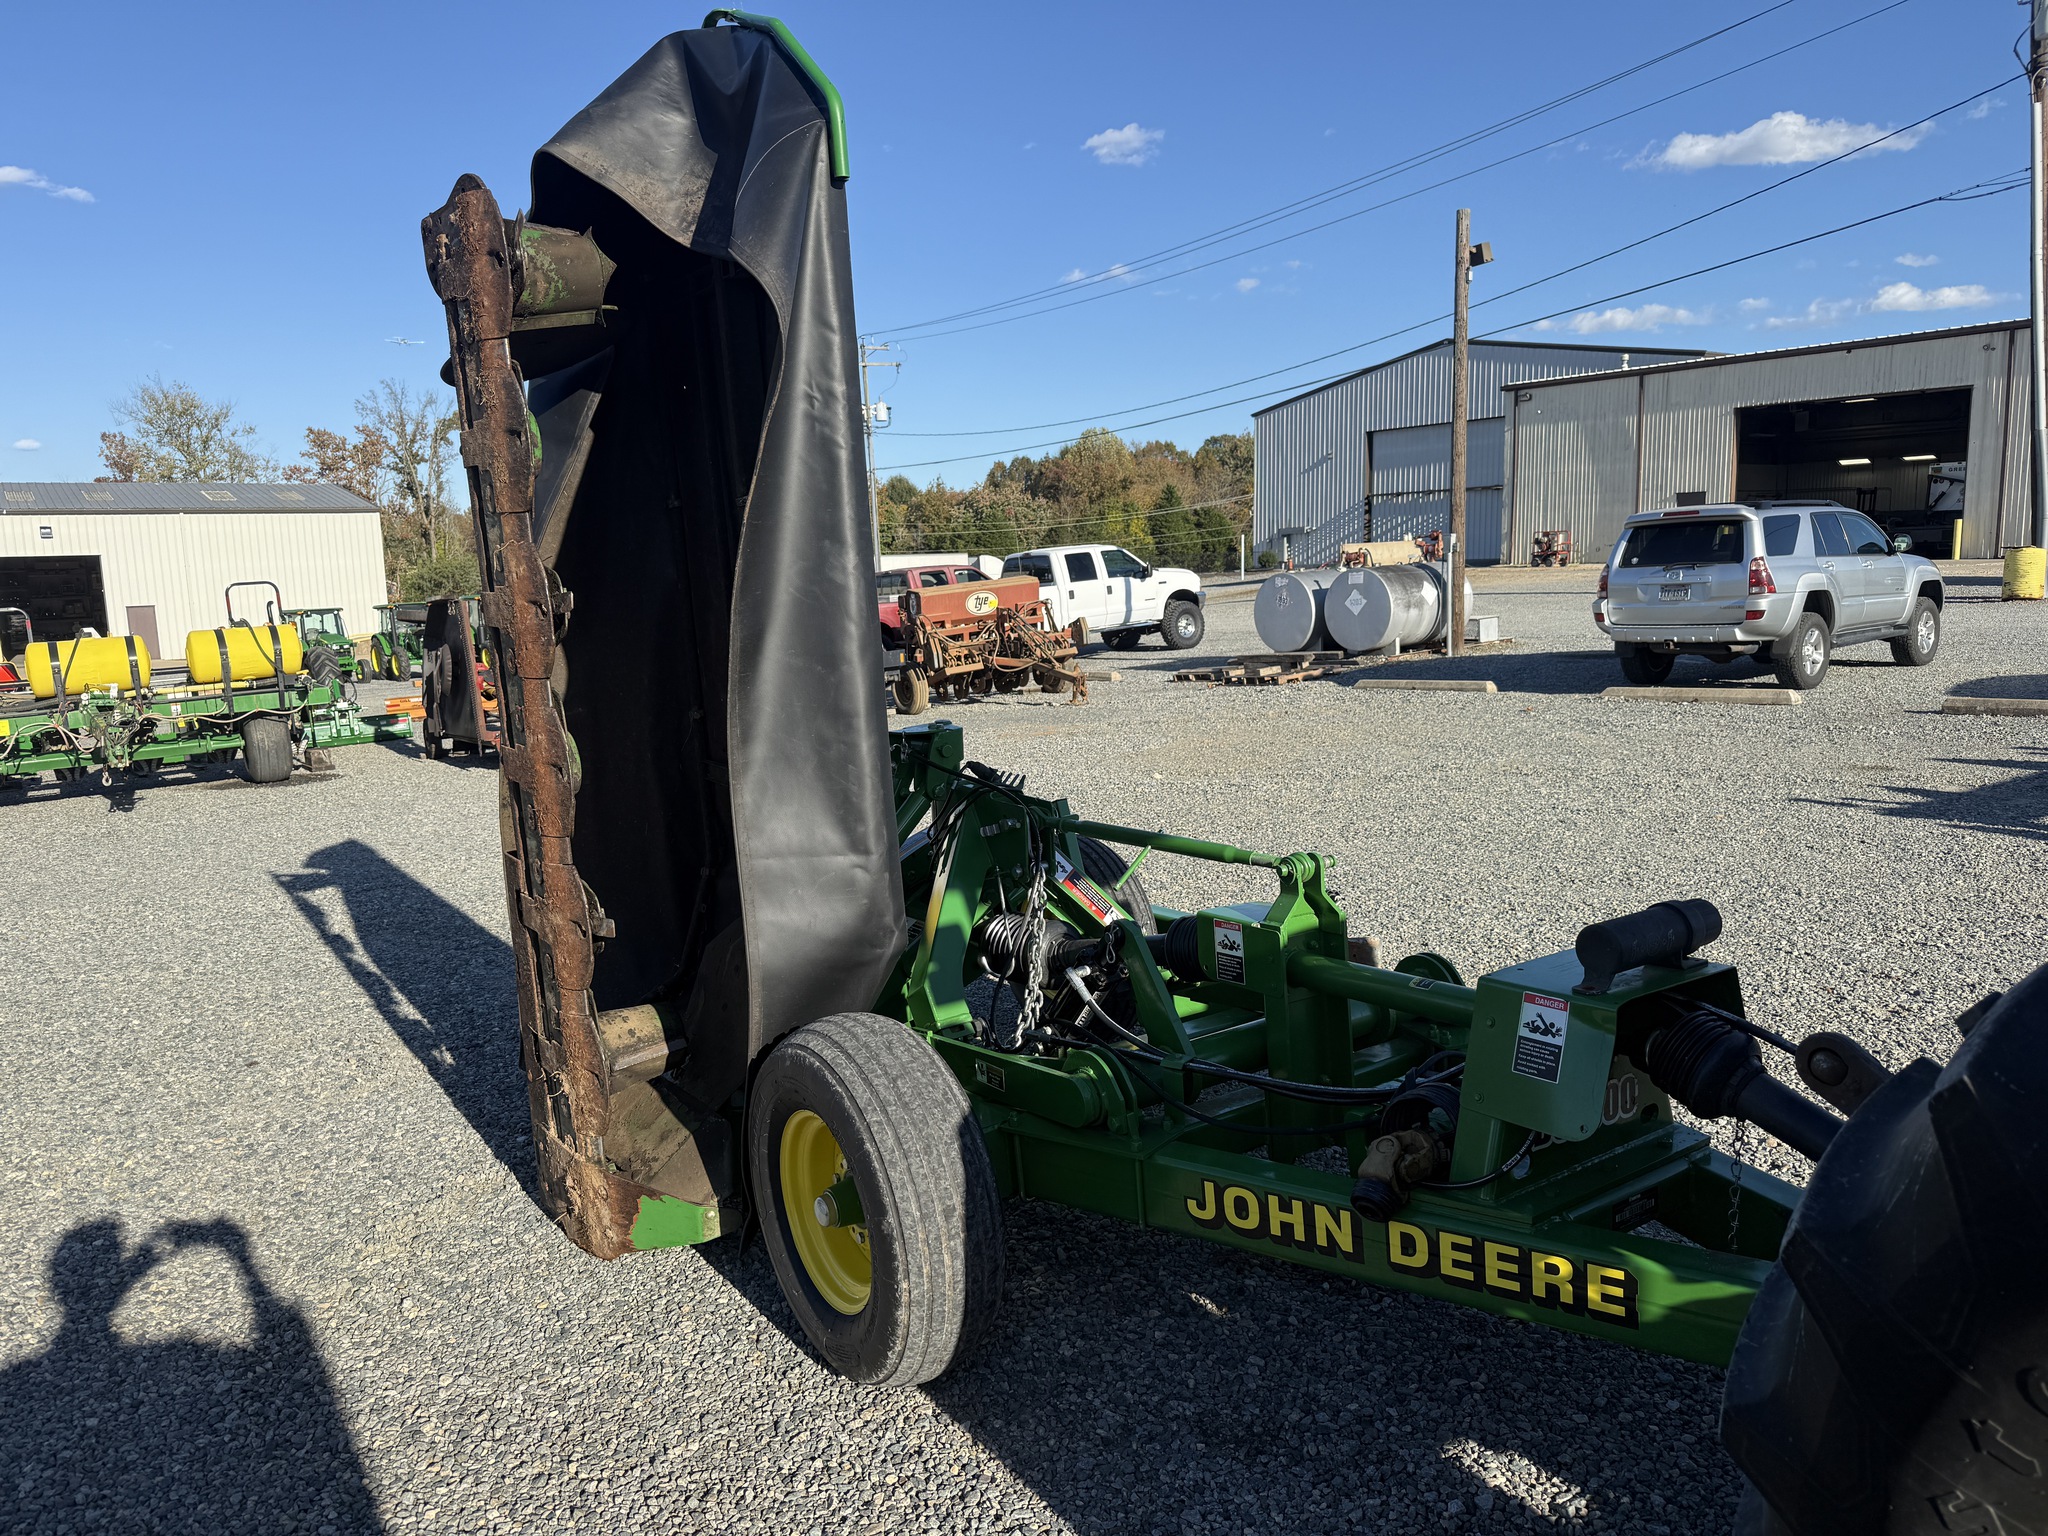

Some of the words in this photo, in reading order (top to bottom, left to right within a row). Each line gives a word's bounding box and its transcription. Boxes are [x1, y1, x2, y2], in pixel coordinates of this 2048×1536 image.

[974, 595, 989, 612] tye
[1221, 922, 1239, 930] DANGER
[1535, 997, 1564, 1010] DANGER
[1188, 1182, 1352, 1252] JOHN
[1389, 1222, 1625, 1316] DEERE
